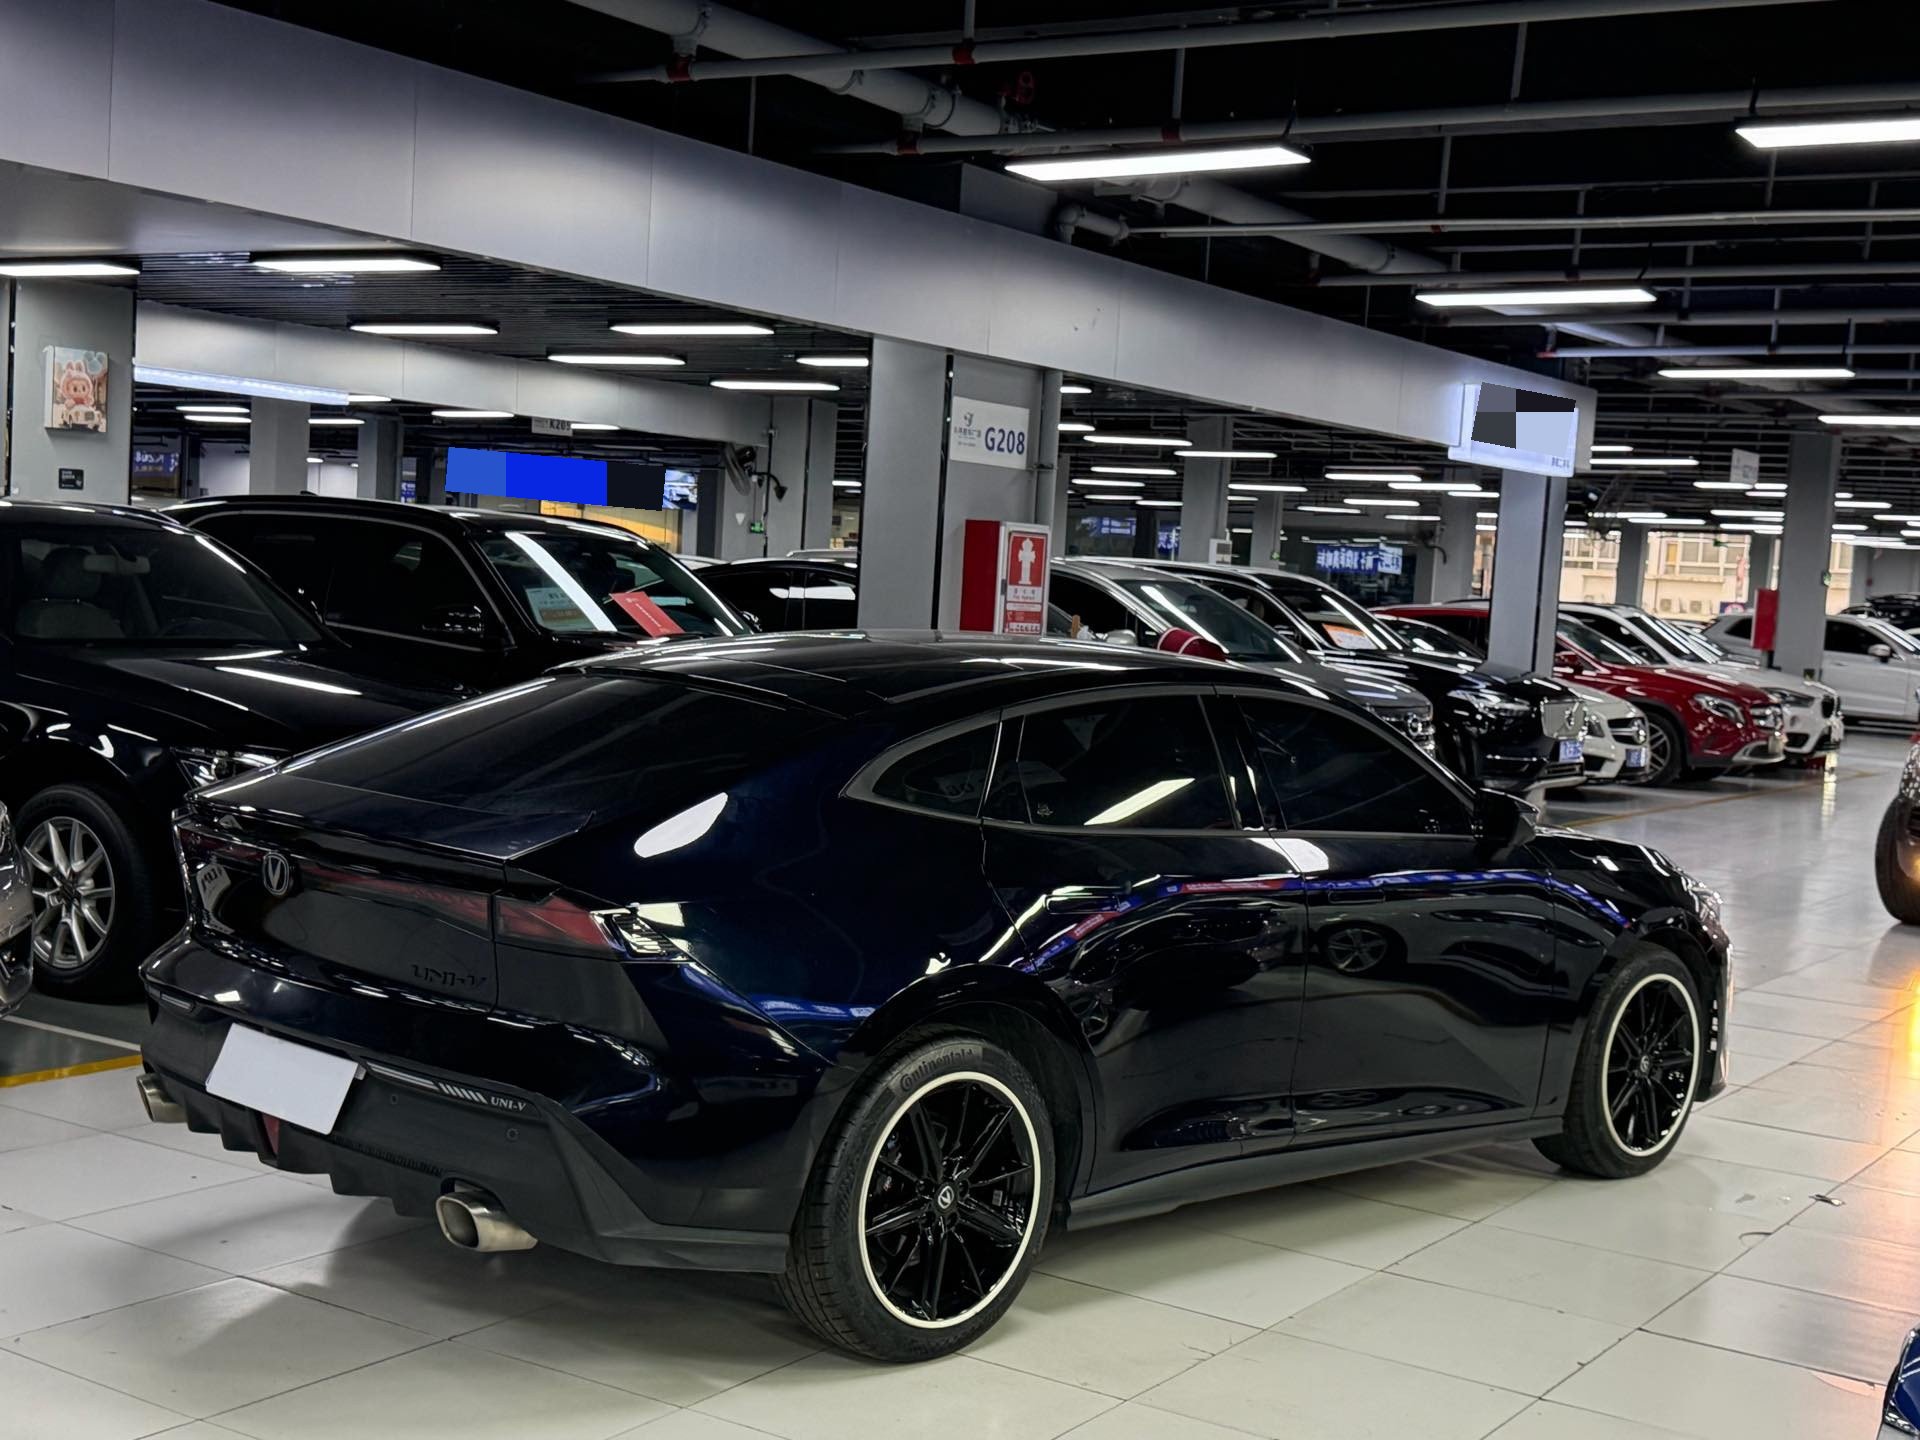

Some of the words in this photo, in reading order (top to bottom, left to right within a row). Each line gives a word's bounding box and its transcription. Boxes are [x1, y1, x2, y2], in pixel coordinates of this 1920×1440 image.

[985, 427, 1025, 455] G208
[900, 1048, 970, 1092] Continental
[490, 1096, 526, 1111] UNI-V
